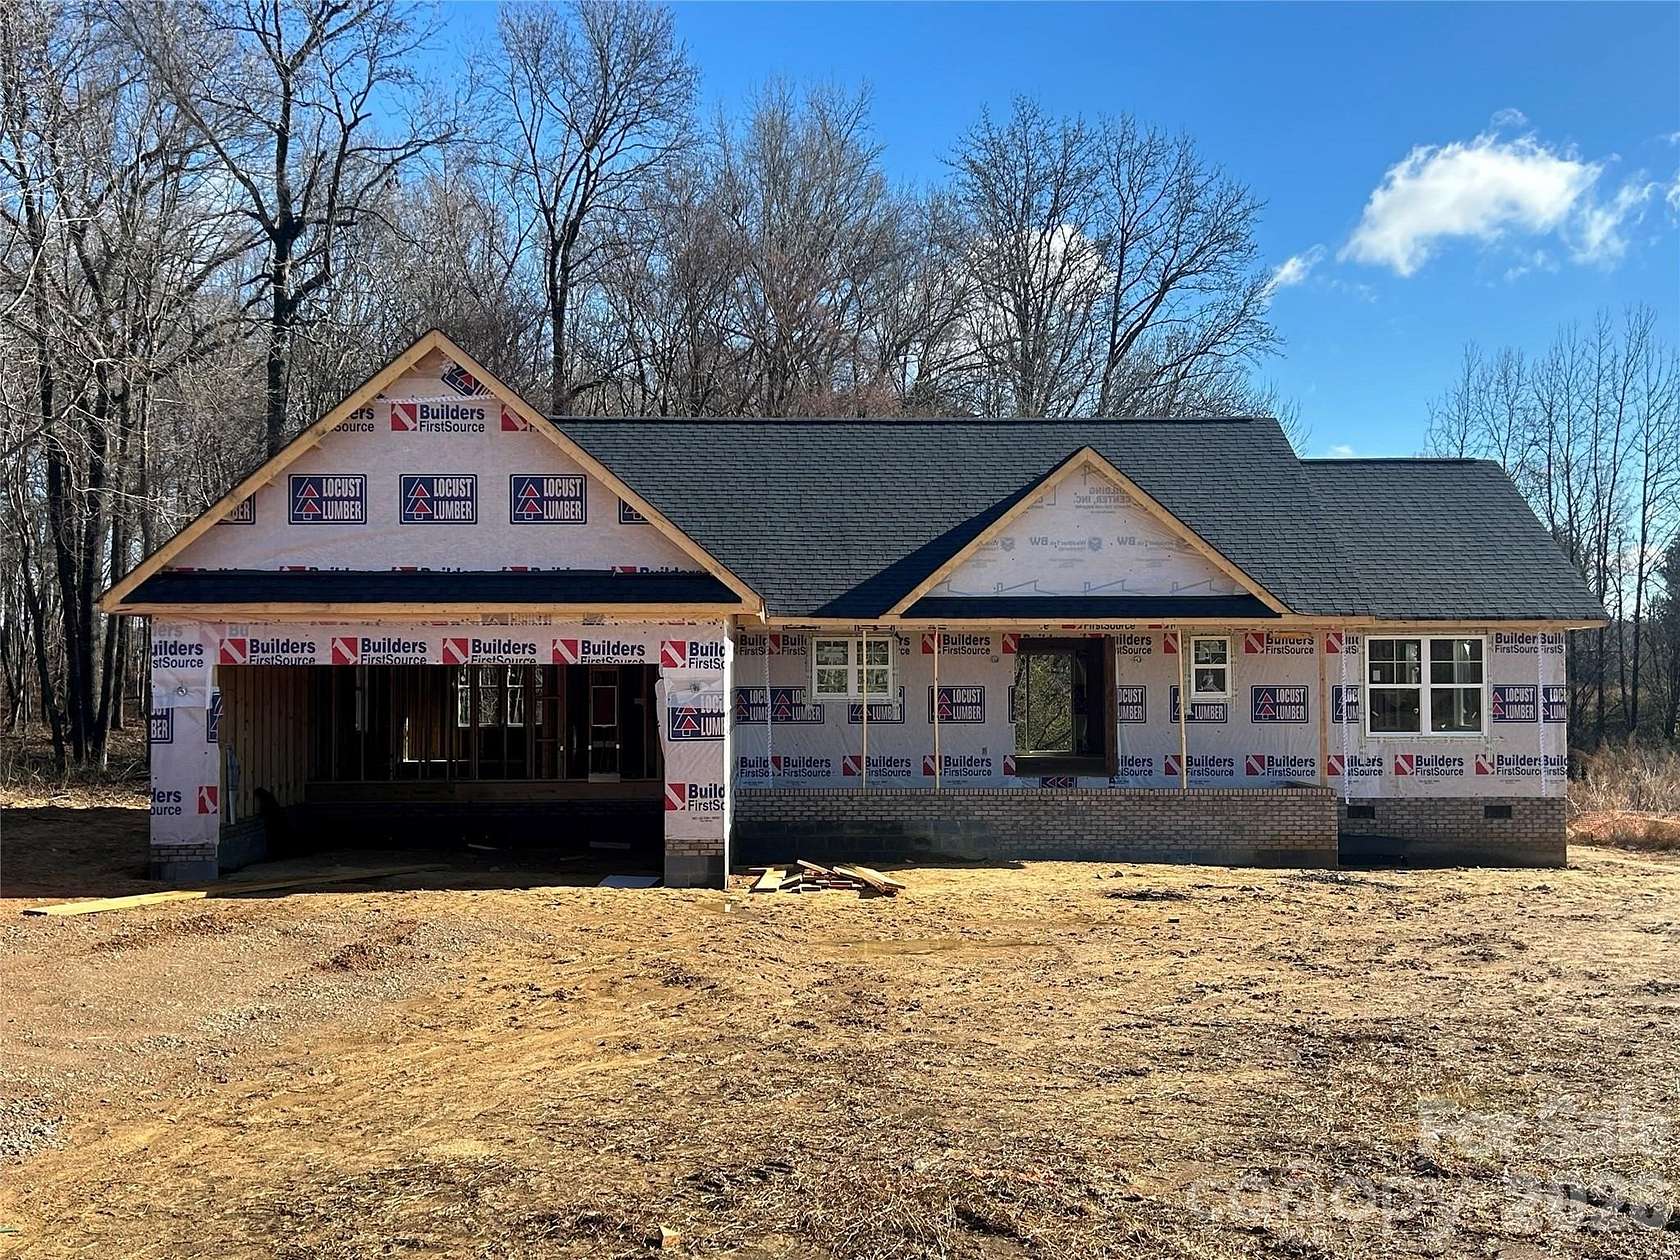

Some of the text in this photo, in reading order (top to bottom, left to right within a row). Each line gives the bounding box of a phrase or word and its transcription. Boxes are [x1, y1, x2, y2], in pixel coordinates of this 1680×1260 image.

[419, 404, 485, 420] Builders
[331, 422, 375, 432] Source
[419, 421, 485, 433] FirstSource
[322, 478, 362, 498] LOCUST
[433, 478, 472, 498] LOCUST
[543, 478, 582, 498] LOCUST
[322, 500, 362, 520] LUMBER
[433, 500, 472, 520] LUMBER
[543, 500, 582, 520] LUMBER
[782, 634, 806, 646] Buil
[942, 634, 991, 645] Builders
[1541, 633, 1564, 644] Buil
[249, 638, 316, 654] Builders
[360, 638, 427, 654] Builders
[471, 638, 537, 655] Builders
[581, 639, 646, 656] Builders
[740, 647, 766, 656] FirstS
[942, 646, 991, 655] FirstSource
[1266, 646, 1314, 655] FirstSource
[1495, 645, 1539, 654] FirstSourc
[249, 654, 316, 664] FirstSource
[360, 654, 427, 664] FirstSource
[471, 655, 537, 664] FirstSource
[952, 689, 982, 703] LOCUST
[1275, 689, 1305, 703] LOCUST
[1505, 688, 1534, 702] LOCUST
[952, 705, 982, 720] LUMBER
[1194, 705, 1224, 720] LUMBER
[1275, 705, 1305, 720] LUMBER
[1505, 704, 1534, 719] LUMBER
[783, 756, 831, 768] Builders
[865, 756, 912, 768] Builders
[943, 756, 992, 768] Builders
[1185, 755, 1234, 767] Builders
[1267, 755, 1316, 767] Builders
[1415, 754, 1464, 766] Builders
[783, 769, 831, 778] FirstSource
[943, 768, 992, 777] FirstSource
[1185, 767, 1234, 777] FirstSource
[1267, 767, 1316, 777] FirstSource
[1415, 767, 1464, 776] FirstSource
[1497, 767, 1541, 776] FirstSourc
